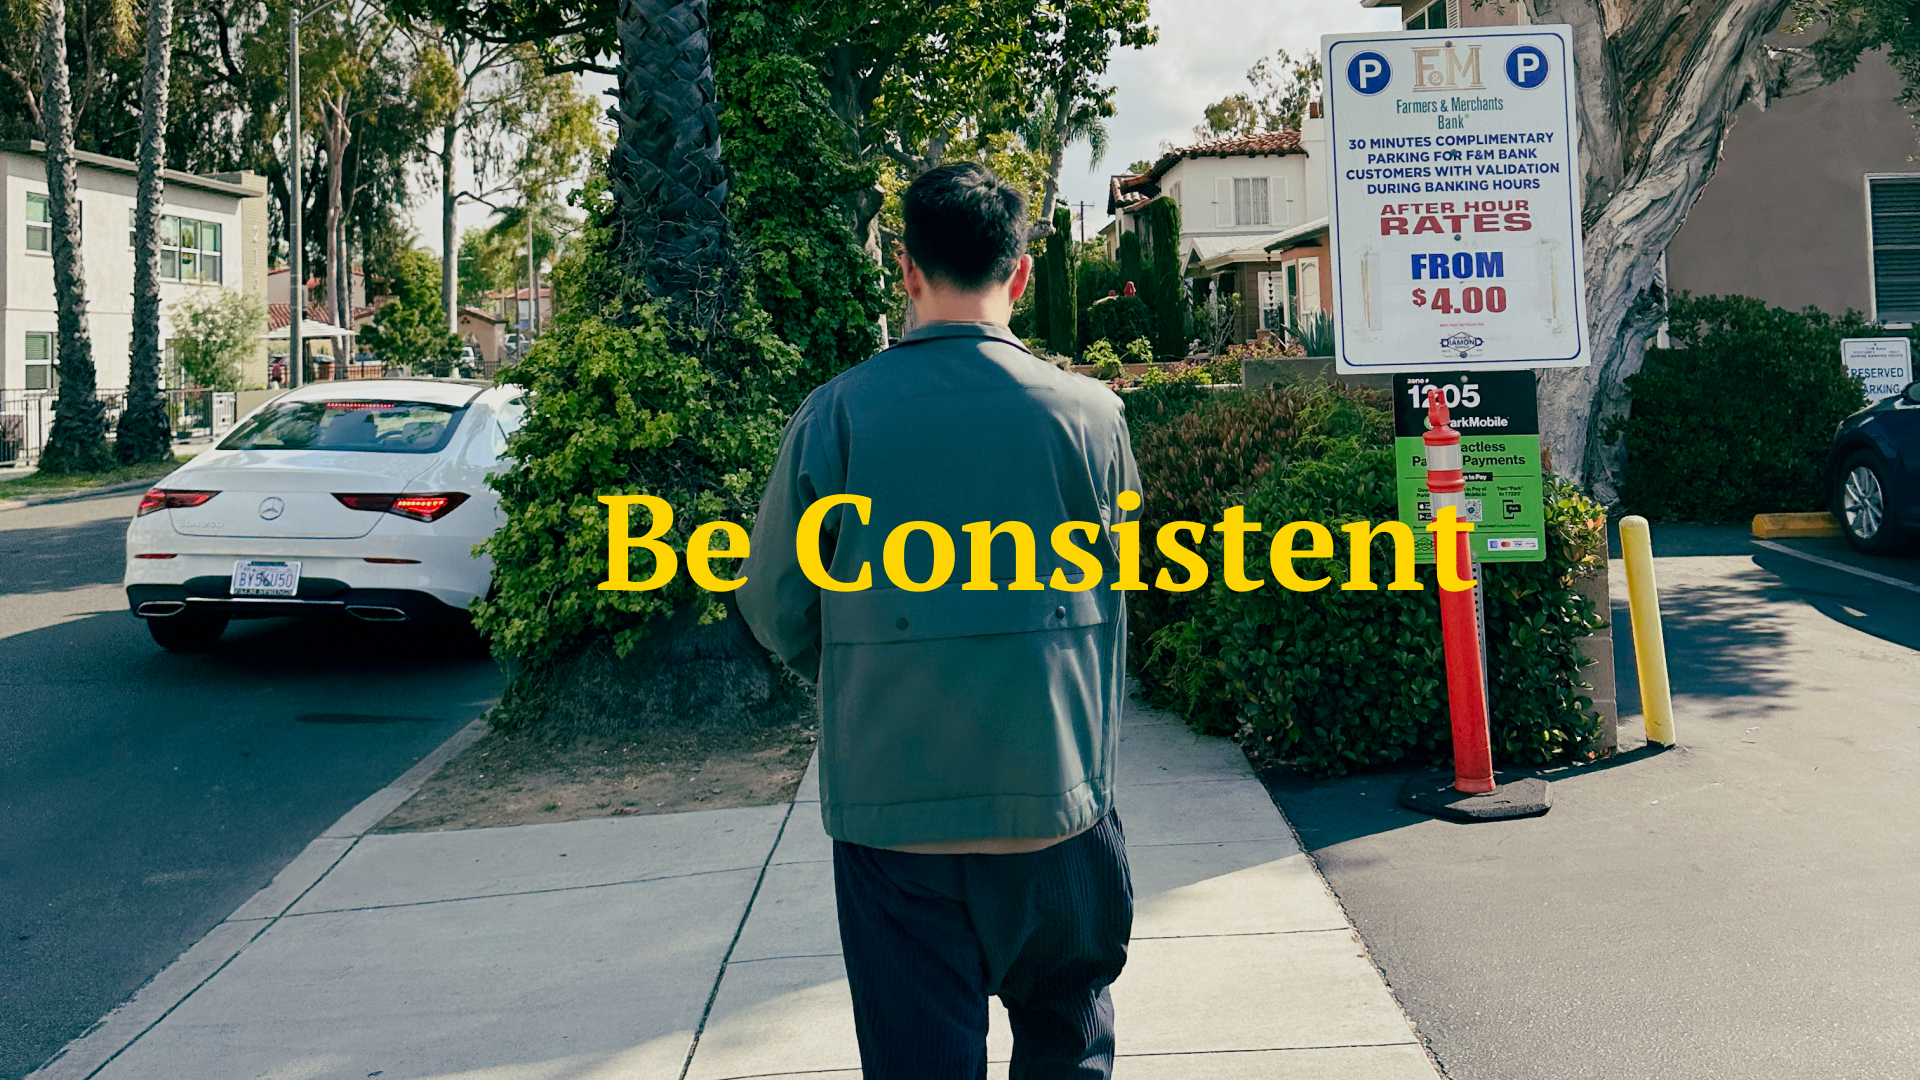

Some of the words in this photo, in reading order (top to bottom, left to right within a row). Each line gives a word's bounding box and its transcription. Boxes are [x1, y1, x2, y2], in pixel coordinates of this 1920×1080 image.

[1359, 60, 1382, 88] P
[1517, 53, 1540, 83] P
[1397, 98, 1438, 114] Farmers
[1440, 100, 1448, 112] &
[1451, 96, 1504, 112] Merchants
[1349, 138, 1366, 150] 30
[1370, 136, 1432, 150] MINUTES
[1436, 132, 1554, 147] COMPLIMENTARY
[1368, 152, 1430, 165] PARKING
[1434, 150, 1462, 163] FOR
[1466, 150, 1495, 162] F&M
[1499, 148, 1537, 160] BANK
[1346, 167, 1431, 180] CUSTOMERS
[1435, 166, 1472, 178] WITH
[1476, 162, 1560, 176] VALIDATION
[1367, 182, 1421, 195] DURING
[1426, 180, 1490, 193] BANKING
[1493, 178, 1540, 190] HOURS
[1381, 201, 1455, 215] AFTER
[1464, 200, 1529, 212] HOUR
[1380, 213, 1532, 236] RATES
[1411, 252, 1504, 280] FROM
[1412, 286, 1507, 314] $4.00
[1440, 337, 1484, 348] DIAMOND
[1850, 367, 1904, 378] RESERVED
[1863, 383, 1900, 394] ARKING
[1450, 416, 1509, 428] arkMobile
[1460, 441, 1506, 452] actless
[1462, 454, 1526, 467] Payments
